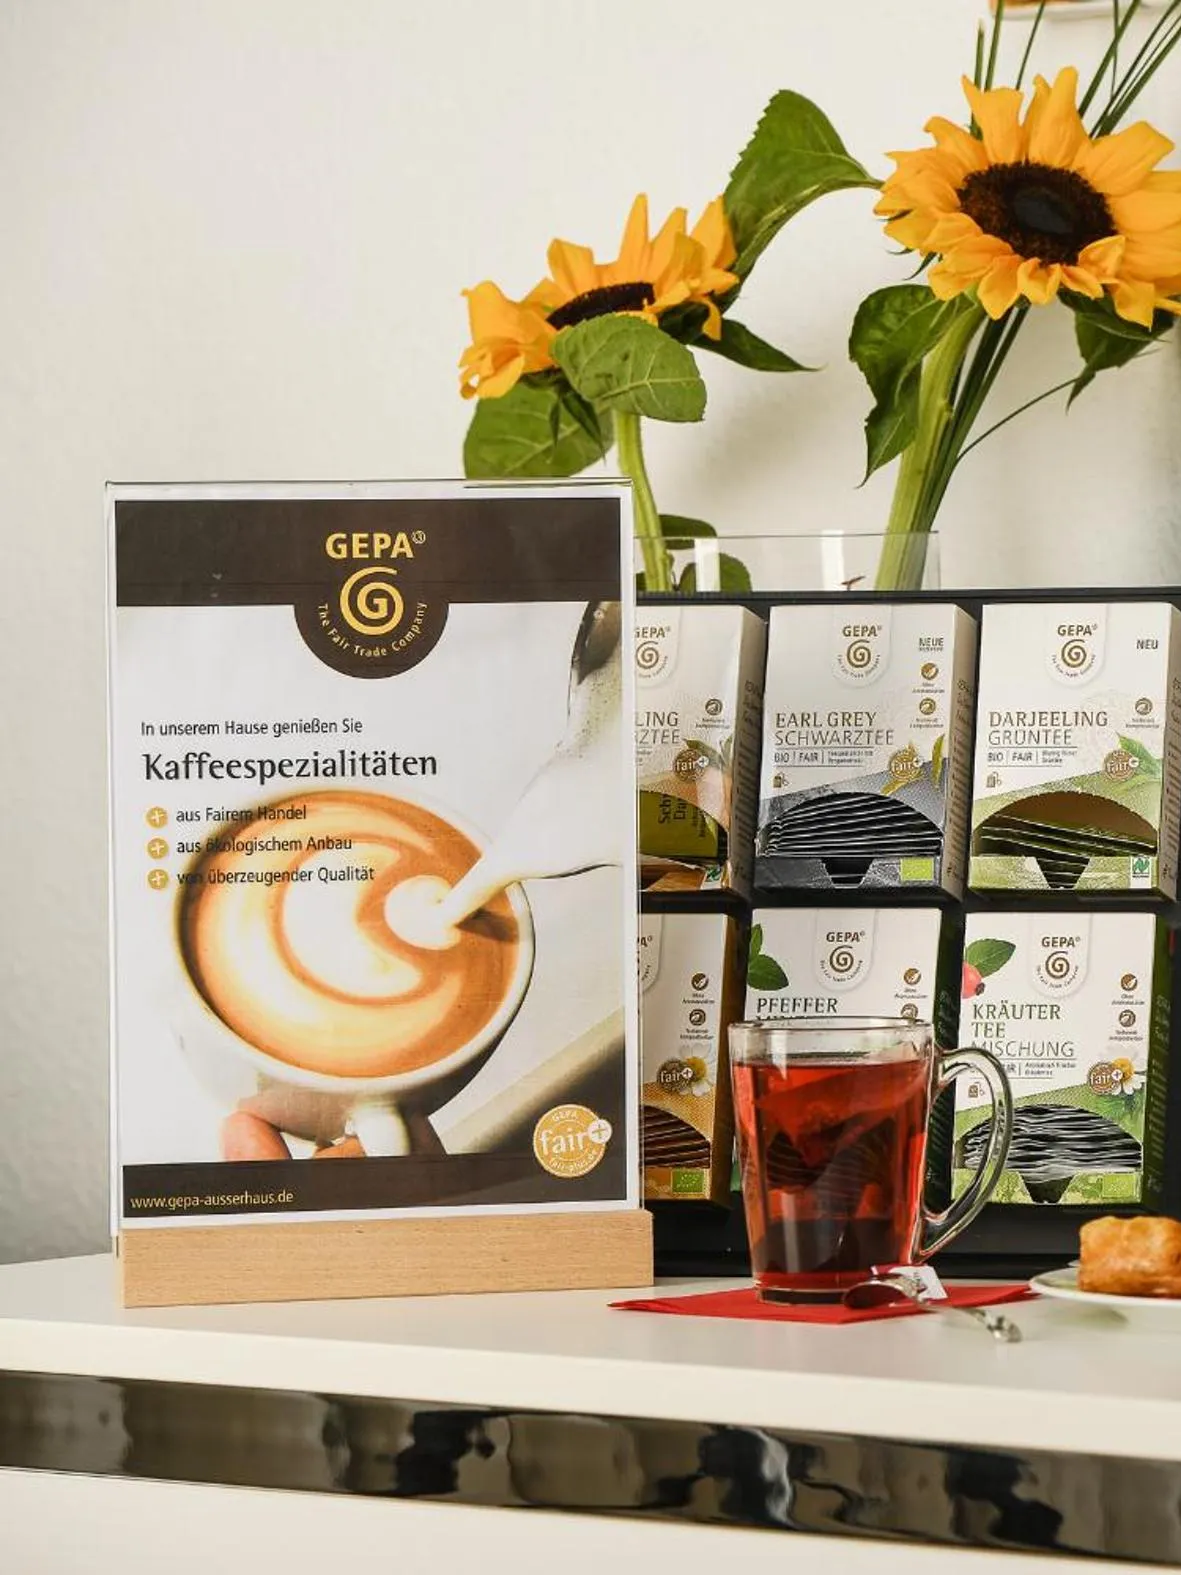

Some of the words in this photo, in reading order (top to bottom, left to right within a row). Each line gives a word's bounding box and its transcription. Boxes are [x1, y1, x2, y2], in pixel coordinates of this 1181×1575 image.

[318, 603, 330, 627] The
[328, 628, 350, 650] Fair
[354, 645, 388, 658] Trade
[391, 602, 428, 652] Company
[1136, 639, 1158, 650] NEU
[776, 711, 823, 727] EARL
[827, 710, 877, 727] GREY
[989, 710, 1109, 728] DARJEELING
[141, 721, 155, 737] In
[160, 724, 220, 737] unserem
[225, 719, 269, 736] Hause
[273, 718, 338, 739] genießen
[342, 717, 364, 734] Sie
[774, 729, 894, 746] SCHWARZTEE
[1012, 751, 1033, 762] FAIR
[143, 749, 438, 785] Kaffeespezialitäten
[176, 810, 201, 822] aus
[206, 807, 253, 822] Fairem
[256, 805, 307, 821] Handel
[177, 841, 201, 854] aus
[206, 838, 302, 856] ökologischem
[306, 836, 352, 851] Anbau
[177, 873, 202, 885] von
[208, 868, 313, 886] überzeugender
[317, 865, 375, 885] Qualität
[756, 997, 838, 1014] PFEFFER
[972, 1000, 1061, 1020] KRÄUTER
[971, 1022, 1006, 1039] TEE
[129, 1189, 294, 1212] www.gepa-ausserhaus.de
